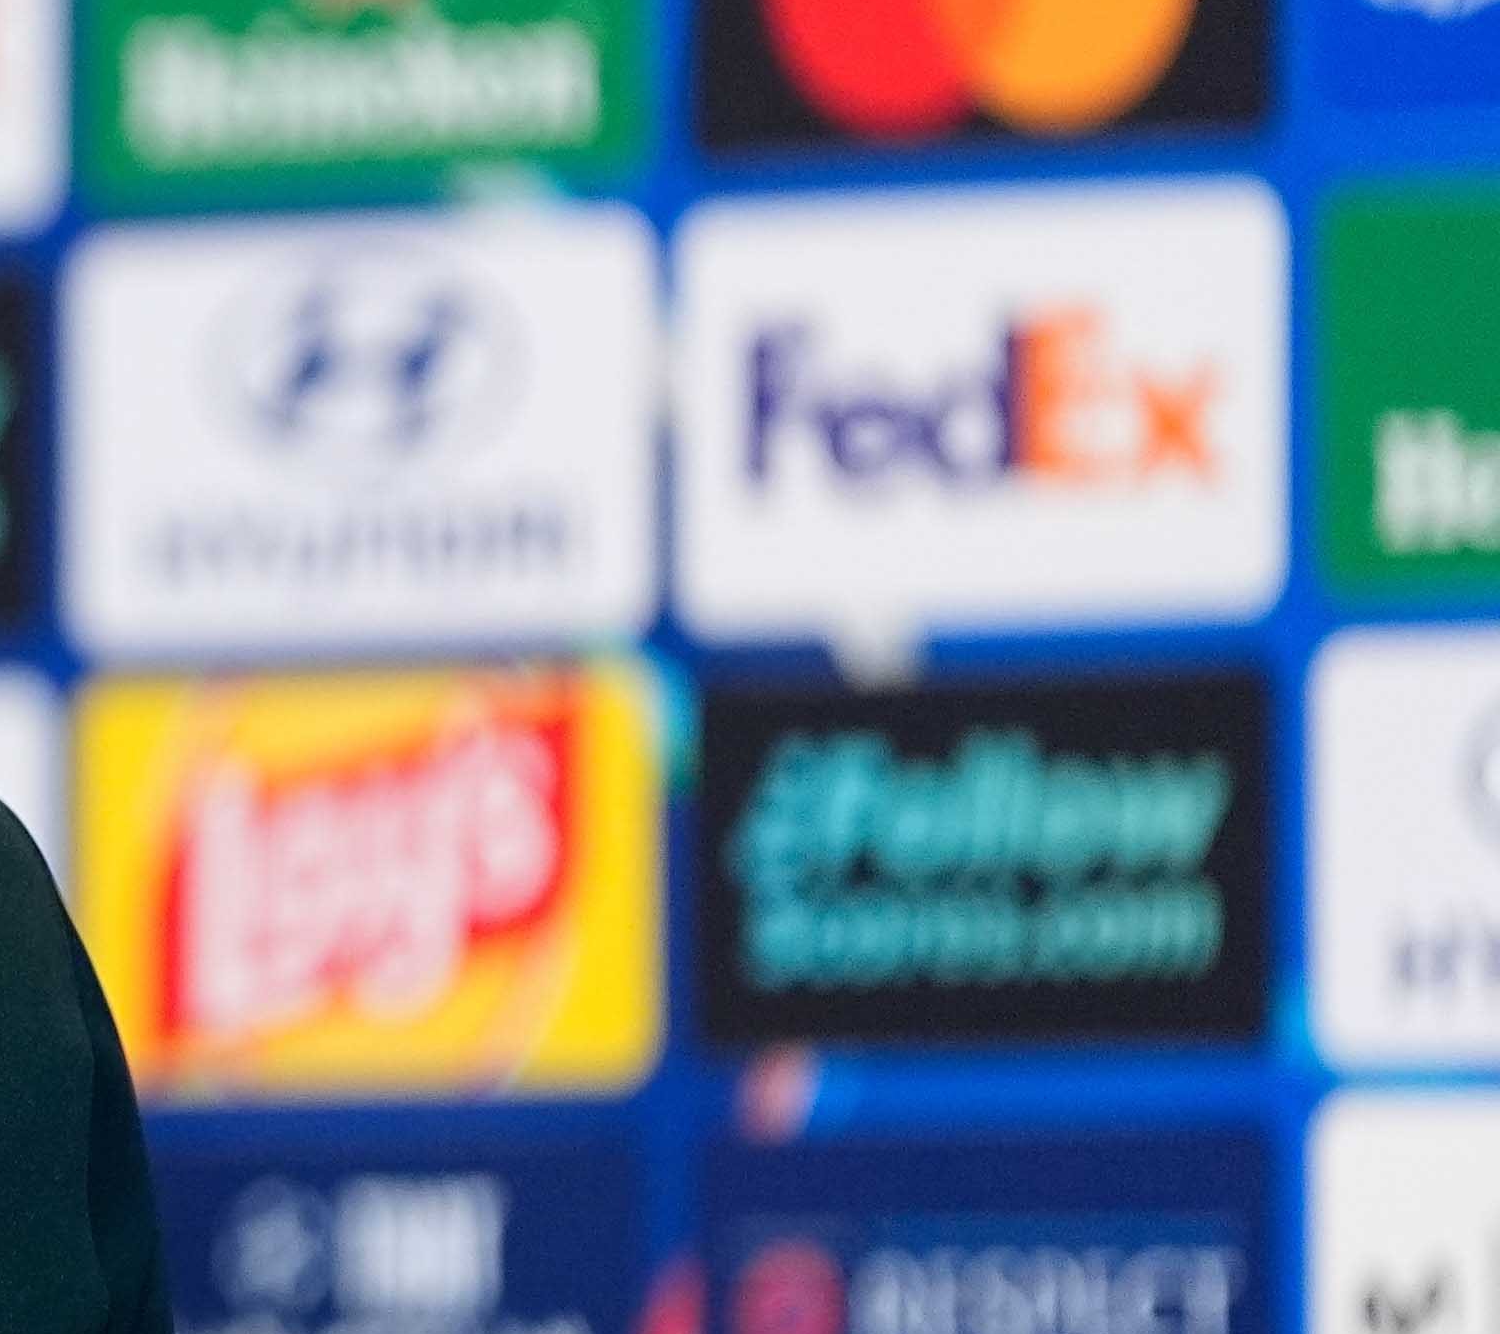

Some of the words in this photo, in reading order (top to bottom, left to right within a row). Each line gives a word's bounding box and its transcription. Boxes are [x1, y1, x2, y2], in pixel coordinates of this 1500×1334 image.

[122, 5, 604, 169] Heineken
[744, 303, 1222, 489] FedEx
[182, 722, 560, 1034] Lay's
